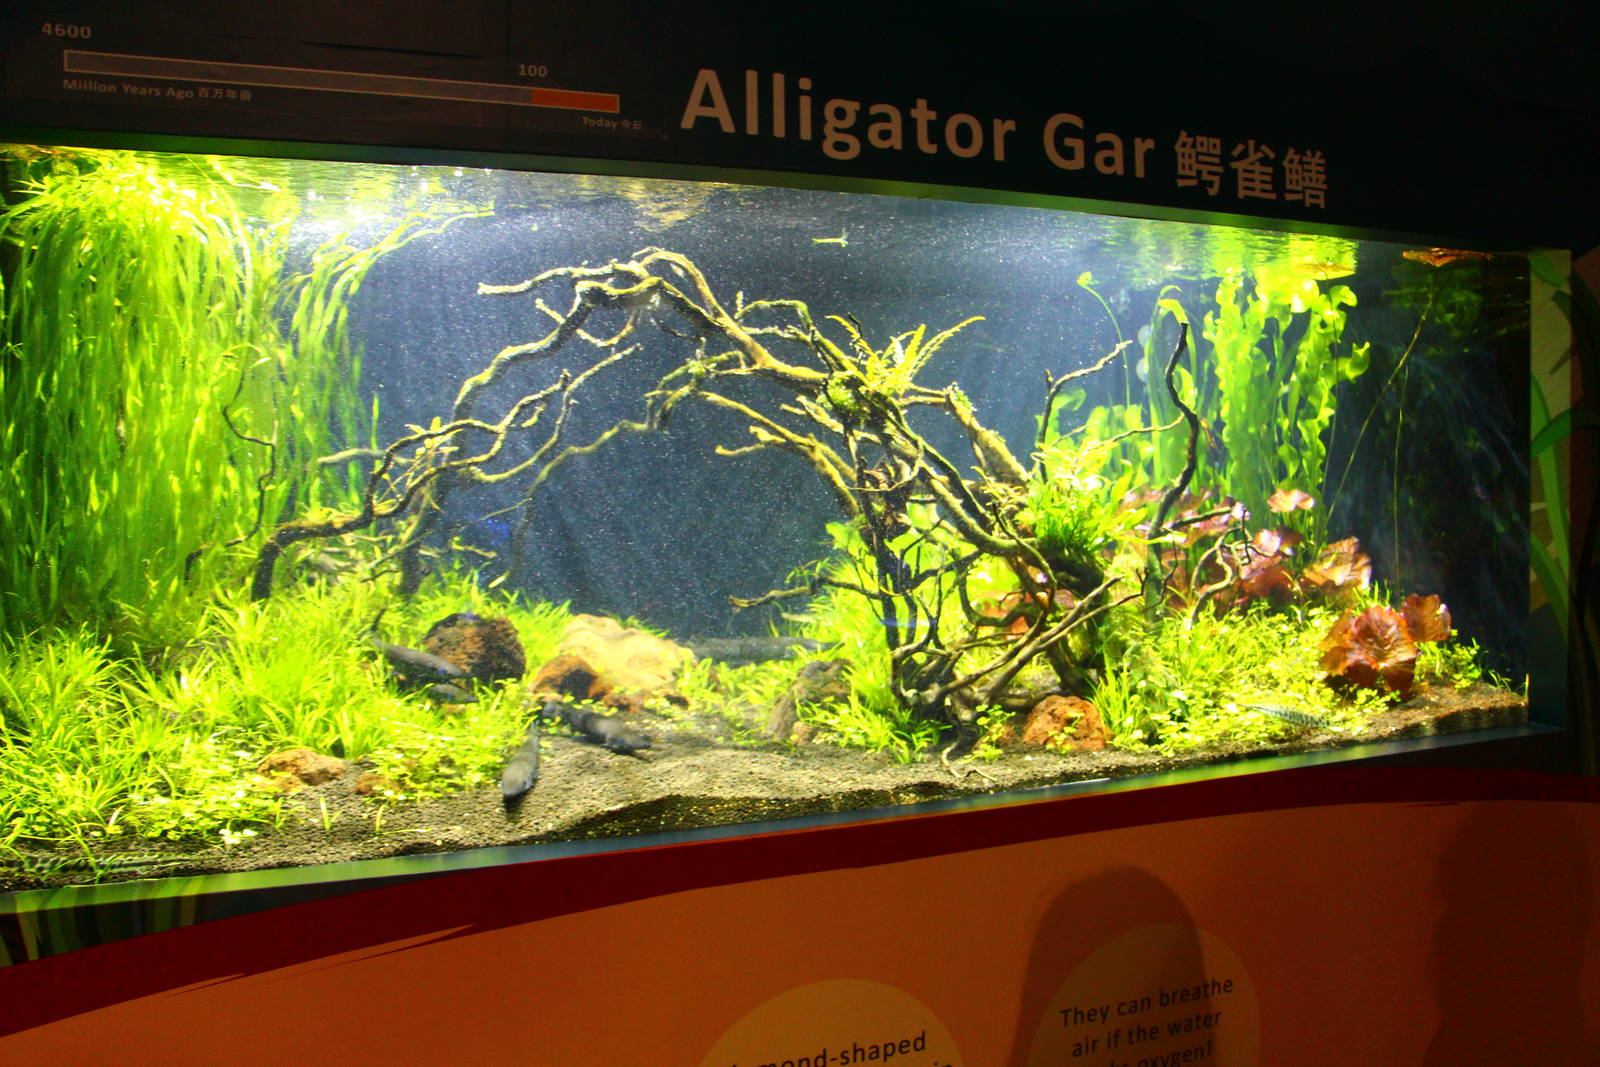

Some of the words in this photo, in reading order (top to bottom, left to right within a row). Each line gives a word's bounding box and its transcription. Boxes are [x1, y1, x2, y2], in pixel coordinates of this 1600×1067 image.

[41, 22, 92, 39] 4600
[518, 64, 548, 78] 100
[63, 79, 117, 93] Million
[121, 83, 161, 96] Years
[166, 87, 193, 100] Ago
[581, 116, 618, 130] Today
[680, 68, 1017, 161] Alligator
[1043, 112, 1155, 178] Gar
[1173, 128, 1329, 209] 鳄雀鳝
[1060, 1005, 1110, 1028] They
[1117, 996, 1151, 1016] can
[1159, 977, 1234, 1007] breathe
[1072, 1037, 1099, 1057] air
[1107, 1028, 1121, 1049] if
[1128, 1024, 1160, 1045] the
[1168, 1010, 1222, 1036] water
[1138, 1040, 1213, 1067] oxygen!
